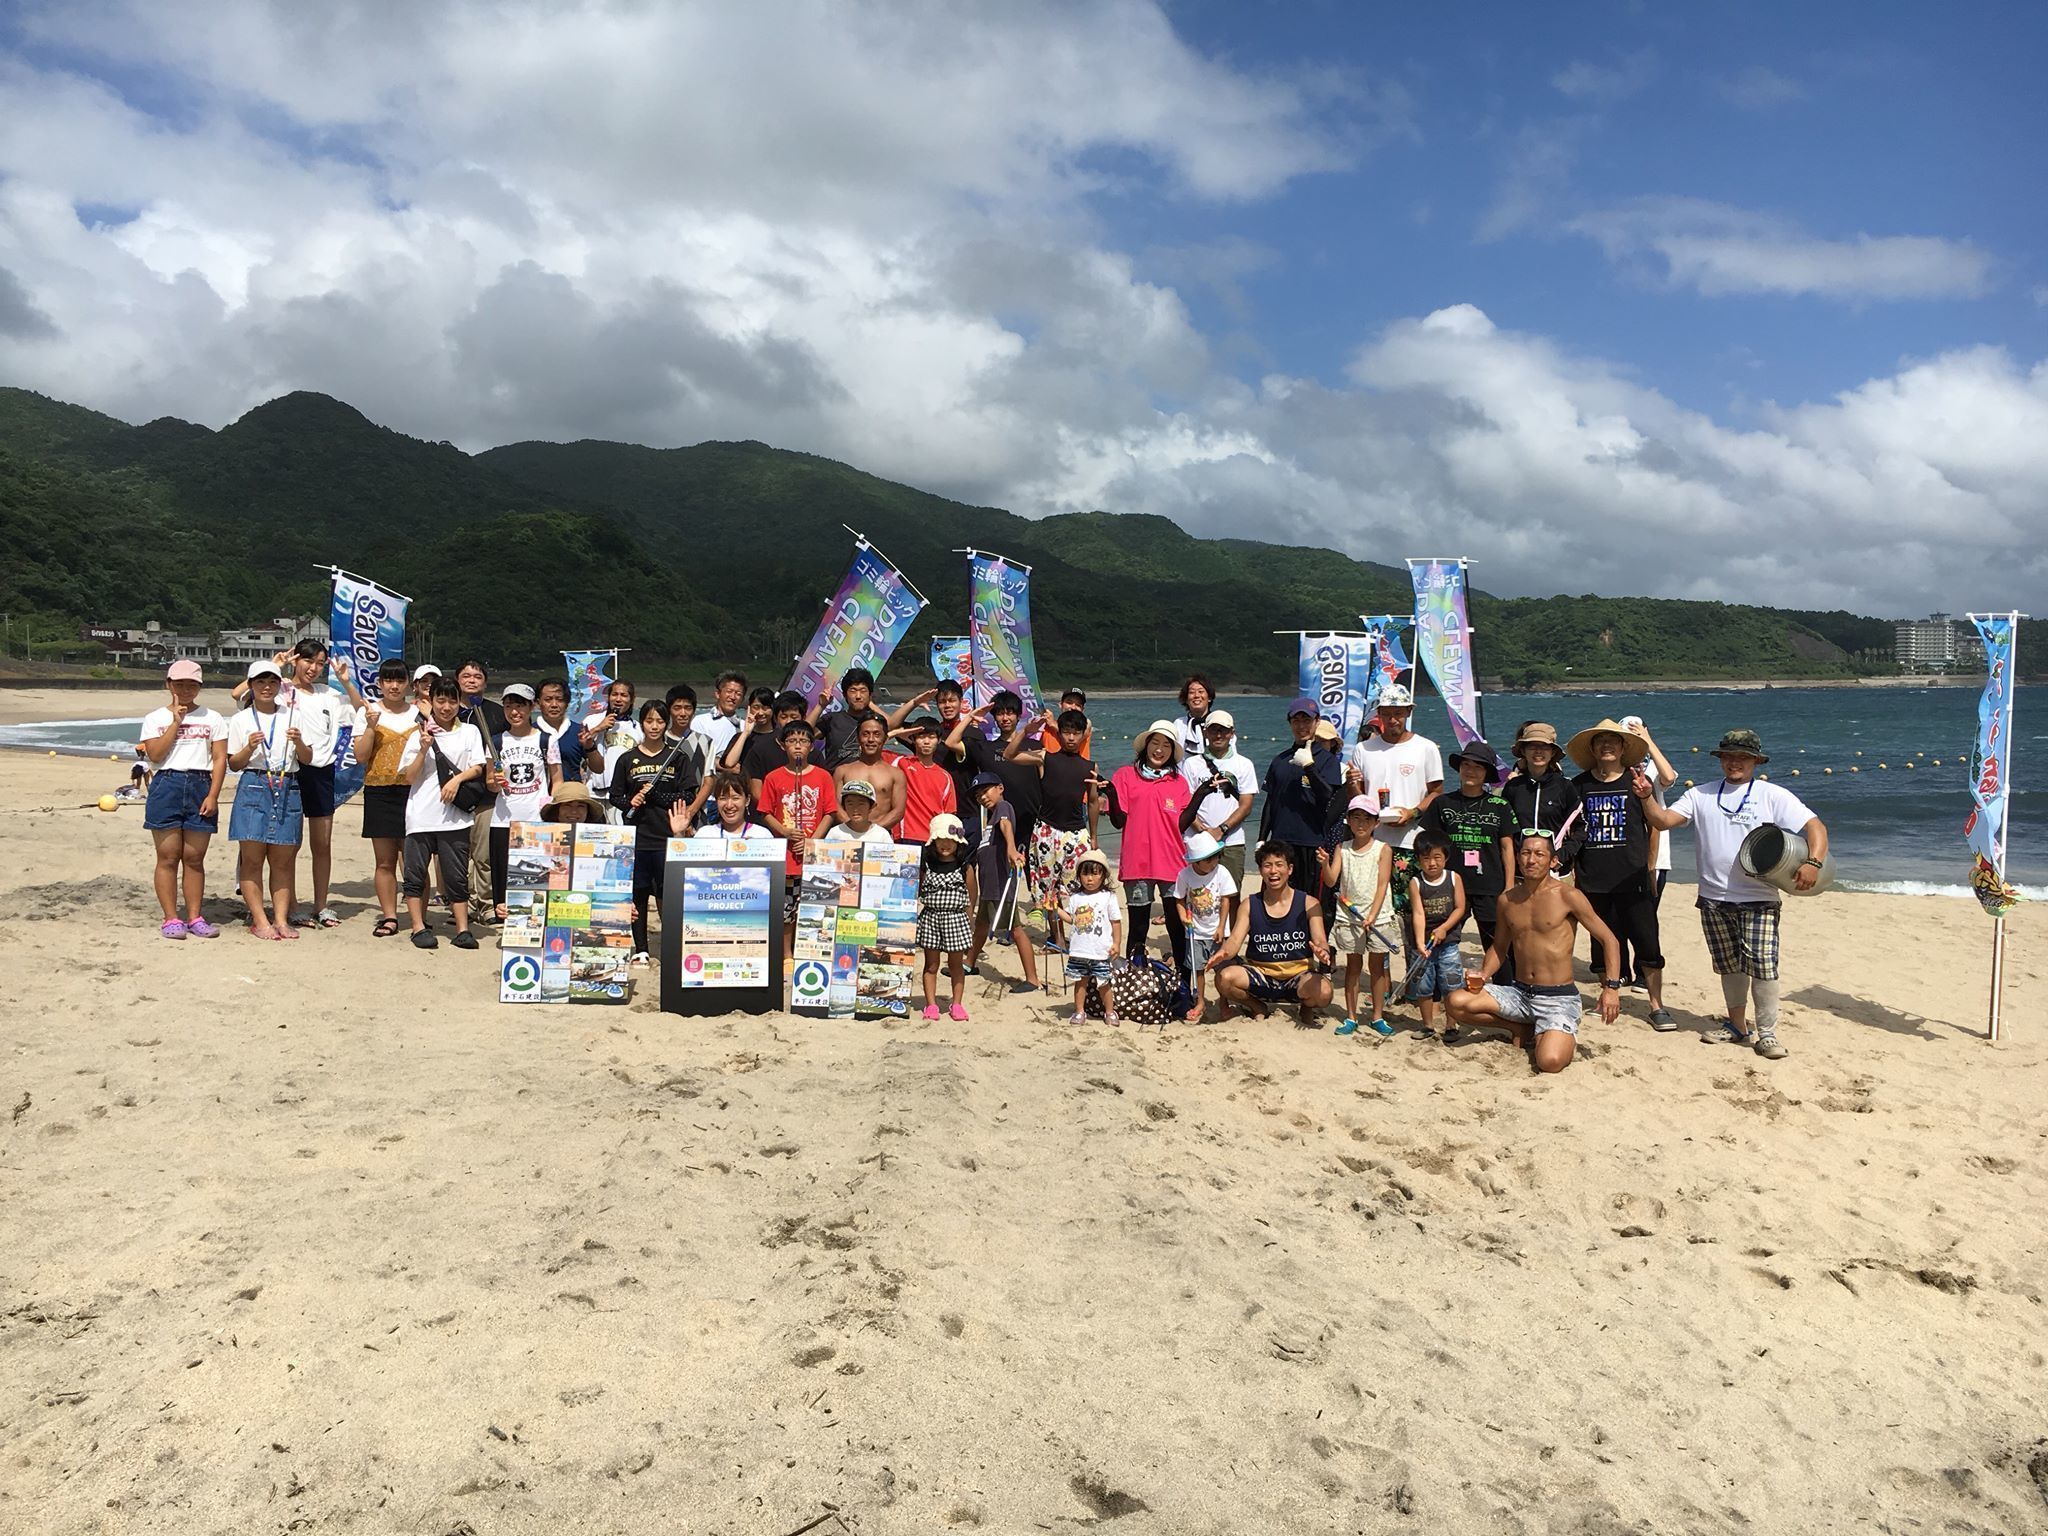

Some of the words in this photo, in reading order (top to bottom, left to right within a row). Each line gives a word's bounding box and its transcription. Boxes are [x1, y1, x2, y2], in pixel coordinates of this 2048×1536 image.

[972, 565, 1027, 594] ゴミ輪ピック
[857, 559, 915, 618] ゴミ輪ピック
[354, 591, 388, 664] Save
[808, 597, 862, 677] CLEAN
[1586, 795, 1628, 811] GHOST
[1601, 811, 1627, 826] THE
[711, 883, 743, 891] DAGURI
[697, 893, 727, 901] BEACH
[729, 892, 758, 900] CLEAN
[708, 902, 745, 910] PROJECT
[1253, 933, 1281, 943] CHARI
[1283, 932, 1290, 940] &
[1292, 931, 1305, 940] CO
[1256, 944, 1278, 953] NEW
[1280, 941, 1306, 951] YORK
